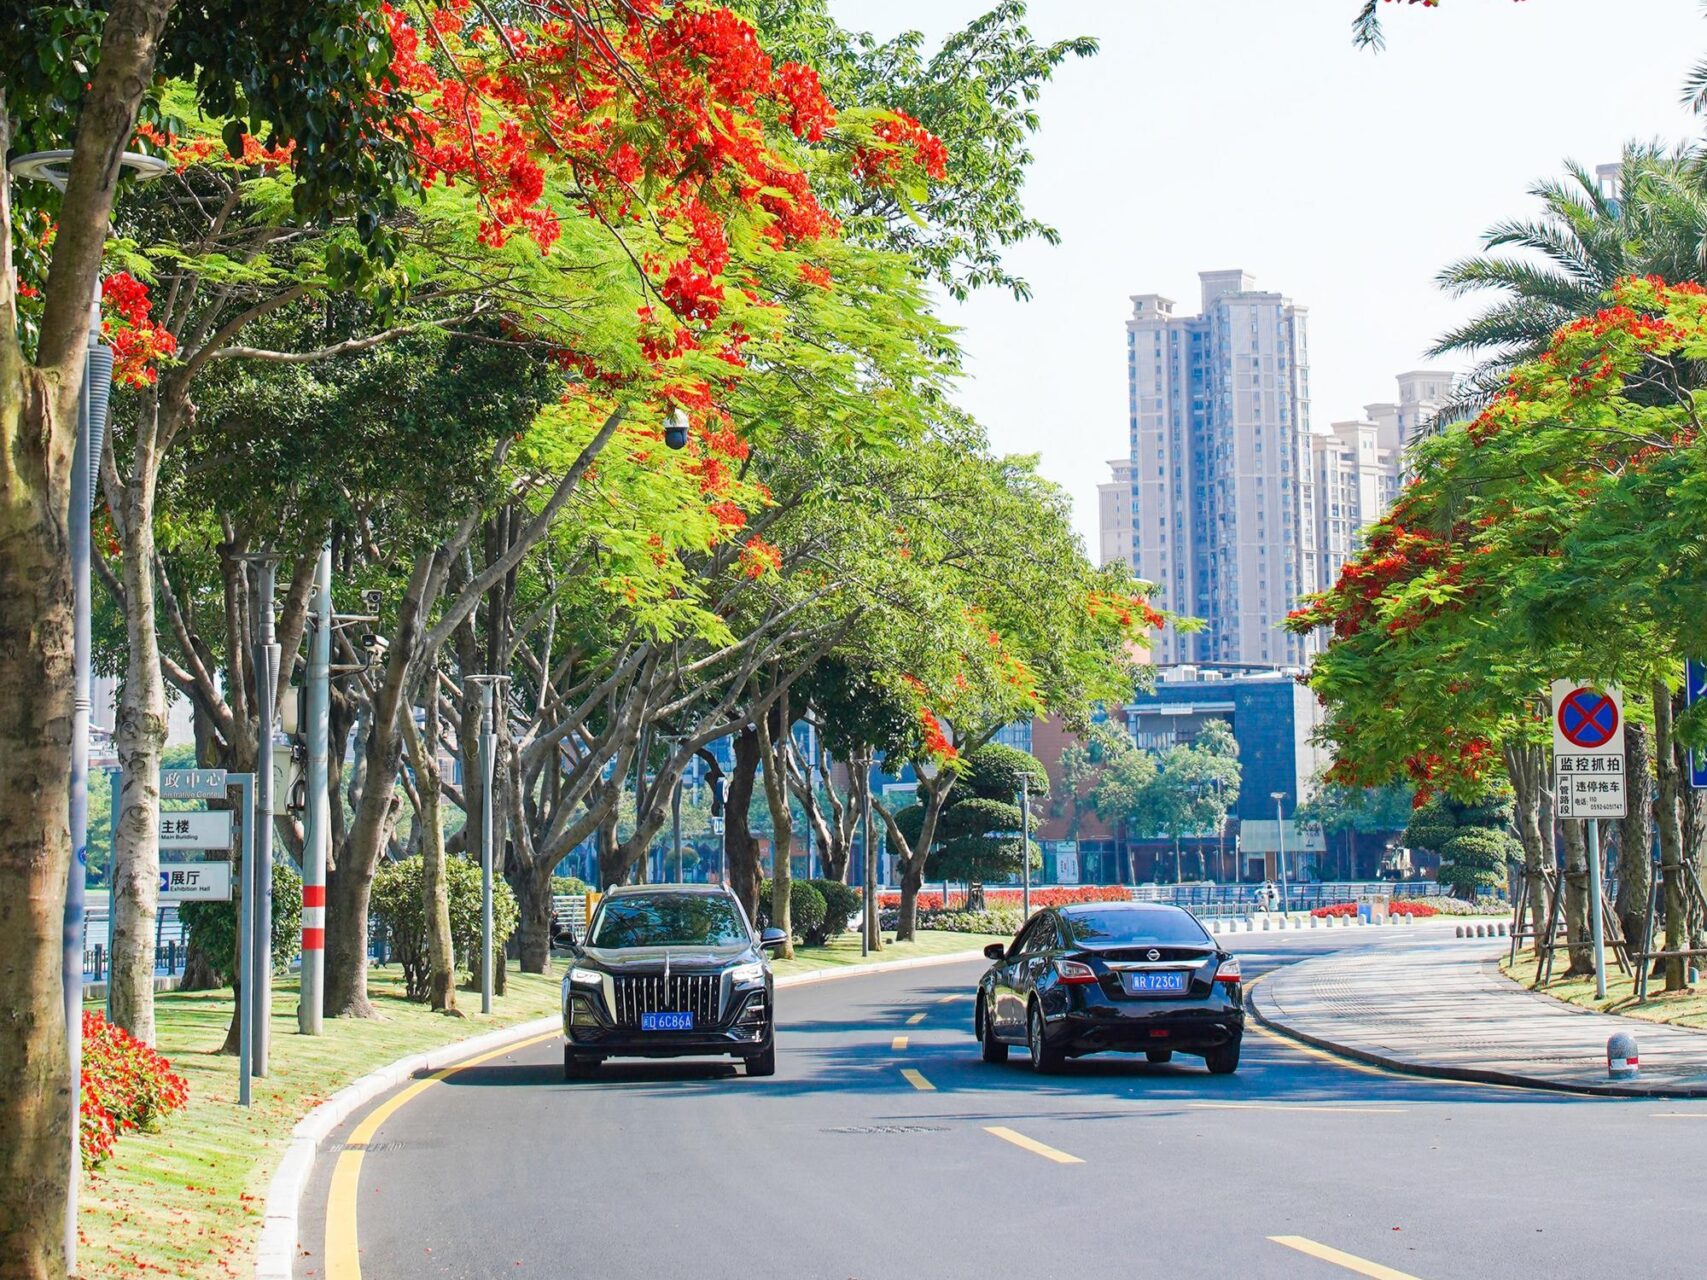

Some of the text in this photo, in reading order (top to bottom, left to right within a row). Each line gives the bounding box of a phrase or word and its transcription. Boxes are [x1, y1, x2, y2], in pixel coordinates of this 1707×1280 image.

[1560, 757, 1620, 771] 监控抓拍
[164, 772, 221, 788] 政中心
[1576, 781, 1620, 792] 违停拖车
[1559, 776, 1570, 814] 严管路段
[161, 819, 189, 834] 主楼
[170, 870, 201, 885] 展厅
